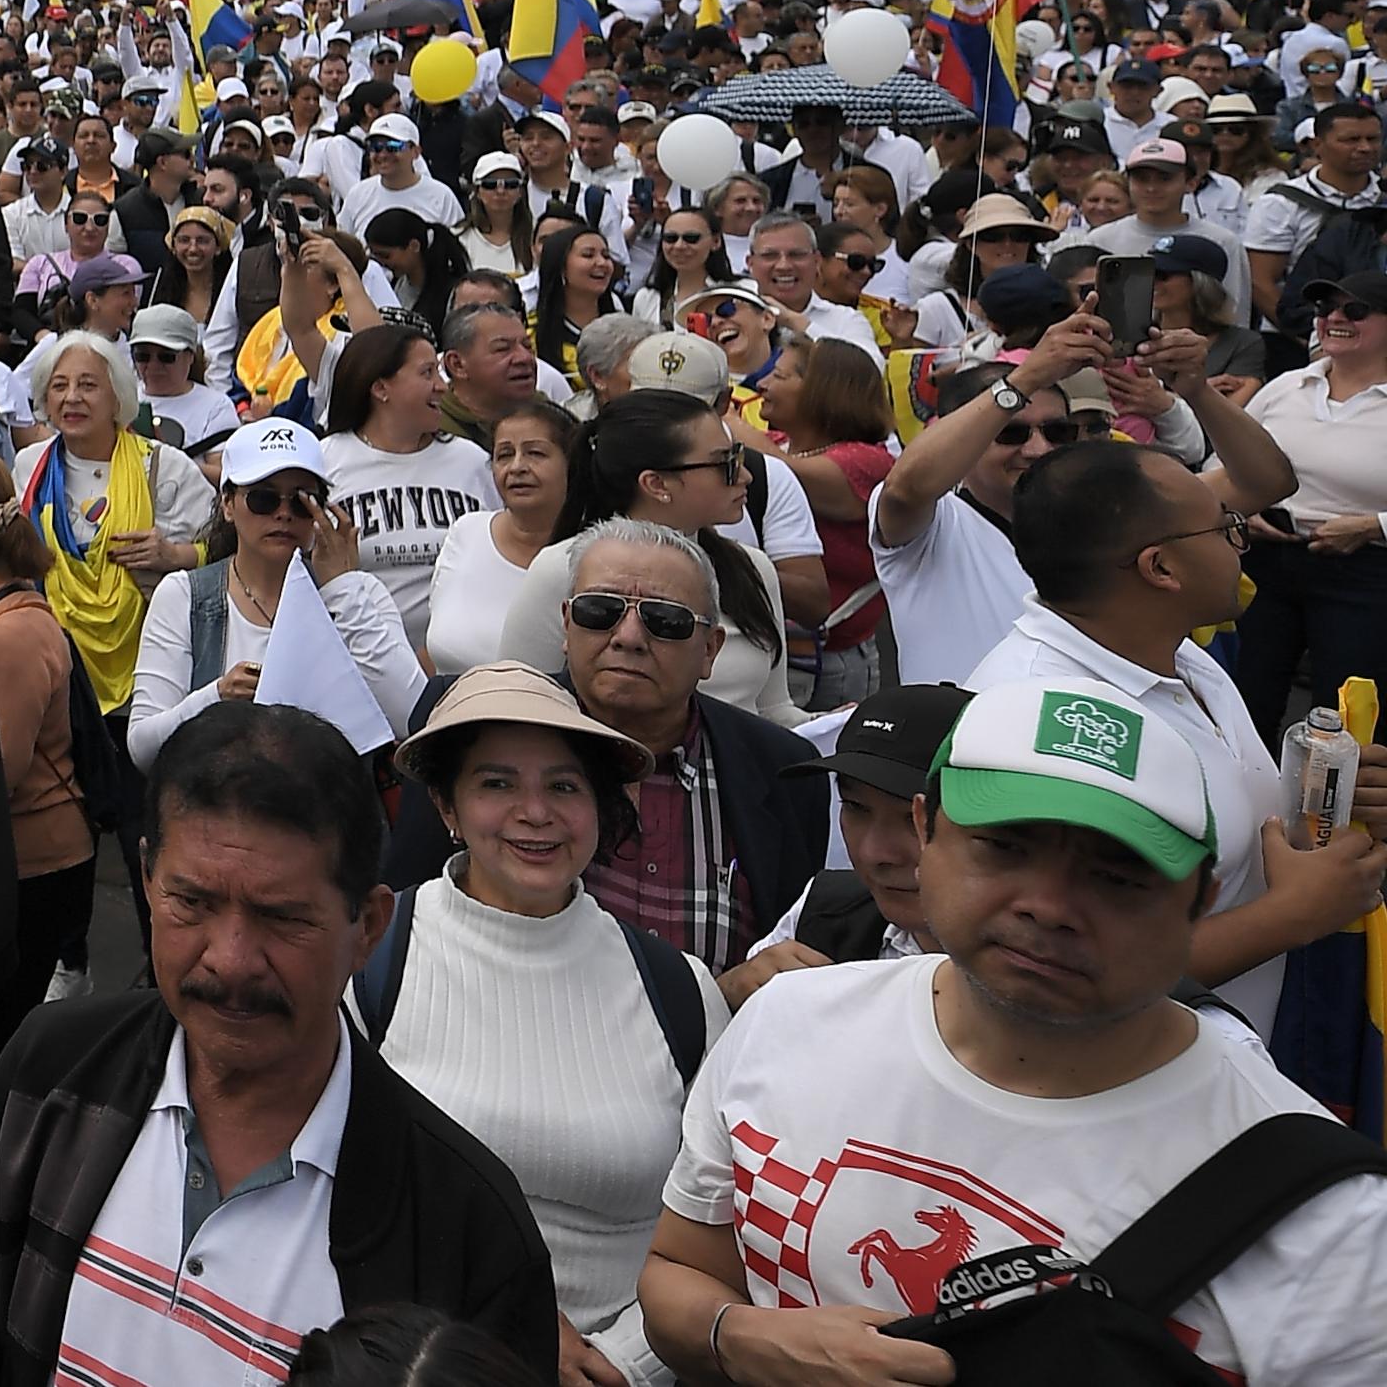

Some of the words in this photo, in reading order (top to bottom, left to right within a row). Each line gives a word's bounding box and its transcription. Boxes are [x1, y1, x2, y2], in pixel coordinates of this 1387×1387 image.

[374, 542, 442, 556] BROOKL
[1051, 742, 1120, 769] COLOMBIA
[938, 1257, 1038, 1306] adidas
